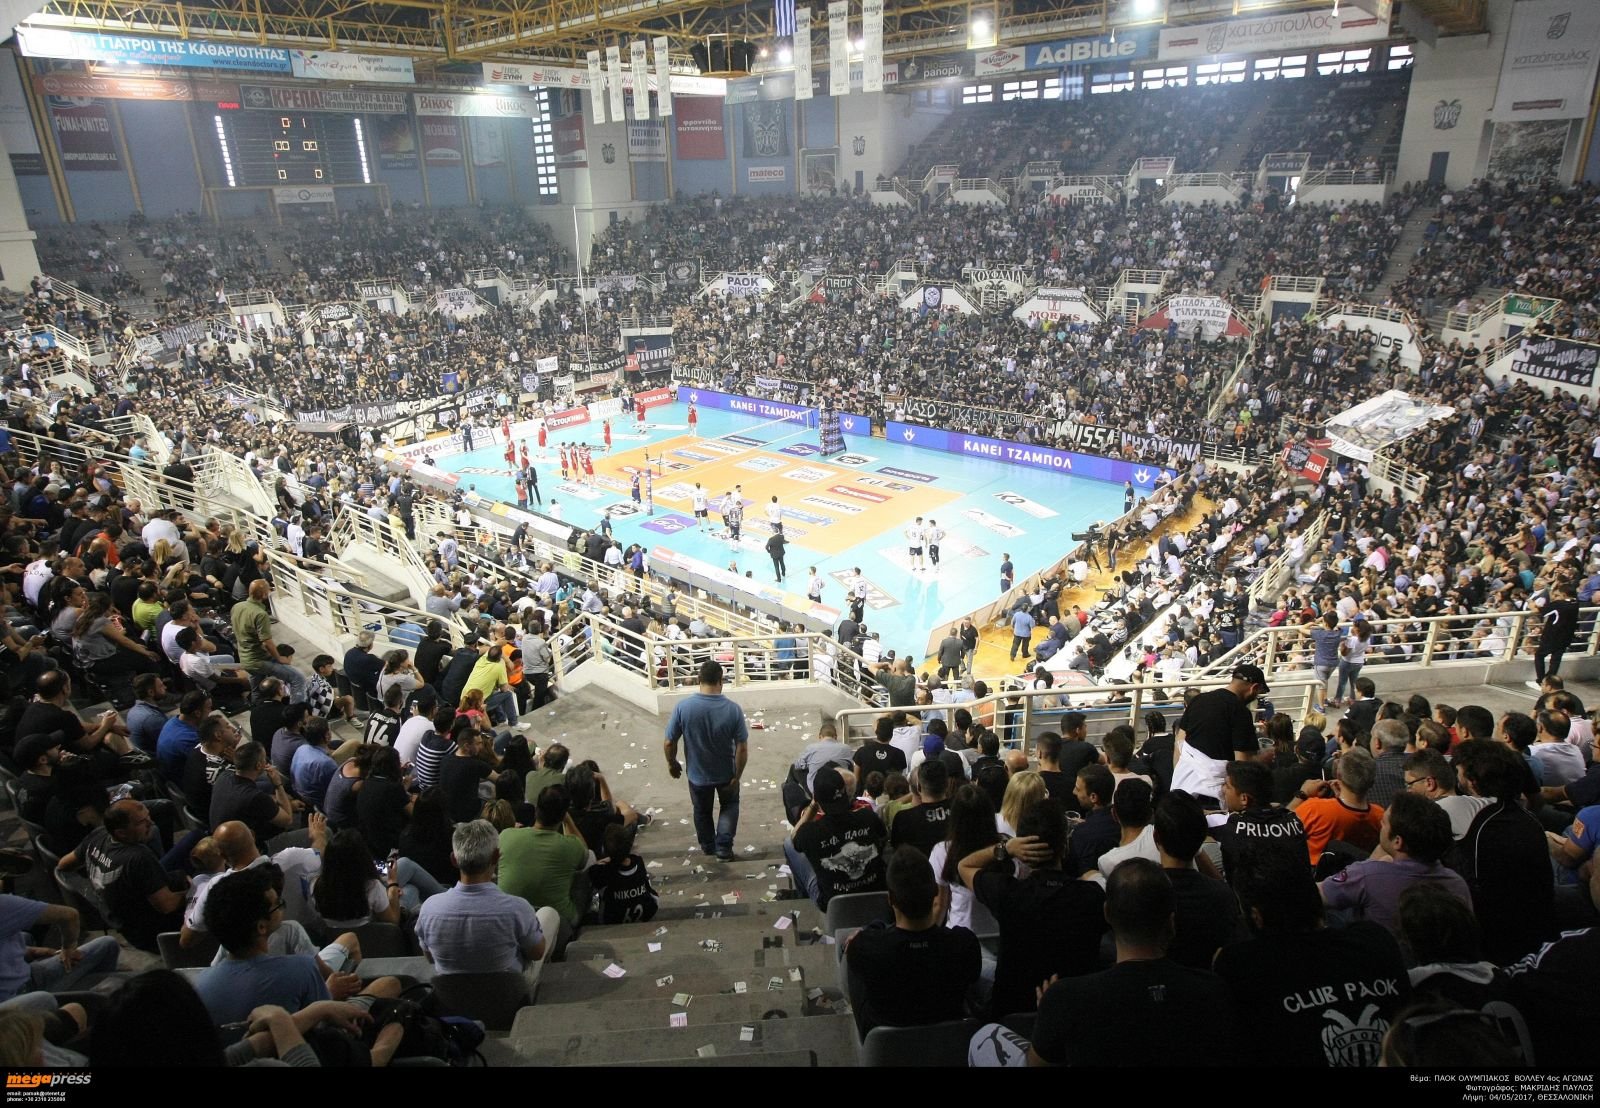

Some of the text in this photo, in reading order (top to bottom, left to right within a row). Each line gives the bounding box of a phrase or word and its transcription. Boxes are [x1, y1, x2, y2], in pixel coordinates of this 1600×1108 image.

[100, 37, 156, 51] ΓΙΑΤΡΟΙ
[157, 41, 186, 54] ΤΗΣ
[188, 43, 287, 61] ΚΑΘΑΡΙΟΤΗΤΑΣ
[1035, 40, 1136, 66] AdBlue
[923, 65, 963, 79] panoply
[750, 168, 784, 177] mateco
[727, 276, 759, 288] PAOK
[1512, 361, 1567, 380] GREVENA
[730, 400, 757, 412] ΚΑΝΕΙ
[964, 440, 1072, 469] ΚΑΝΕΙ ΤΖΑΜΠΟΛ
[1283, 979, 1399, 1013] CLUB PAOK
